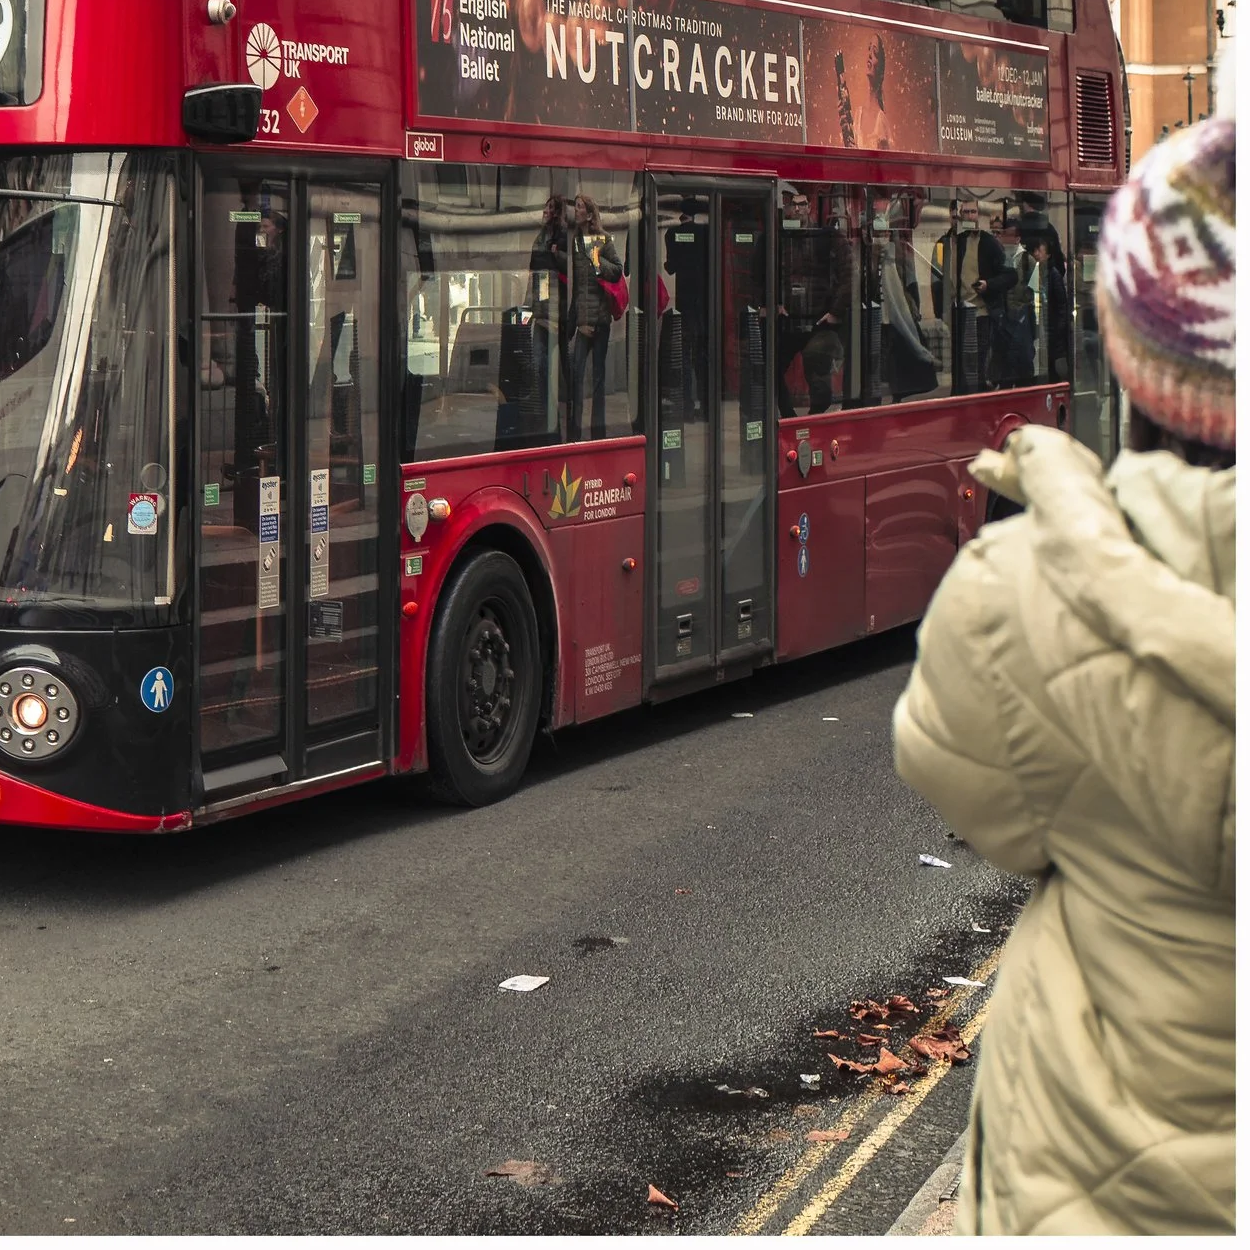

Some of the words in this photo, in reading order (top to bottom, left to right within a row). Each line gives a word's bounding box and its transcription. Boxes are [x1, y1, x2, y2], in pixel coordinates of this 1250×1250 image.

[568, 0, 614, 23] MAGICAL
[616, 8, 672, 31] CHRISTMAS
[674, 16, 723, 38] TRADITION
[460, 22, 515, 53] National
[281, 40, 350, 65] TRANSPORT
[283, 59, 301, 79] UK
[460, 53, 500, 82] Ballet
[545, 22, 801, 105] NUTCRACKER
[1005, 67, 1018, 84] DEC
[1031, 71, 1043, 86] JAN
[975, 86, 1044, 109] ballet.org.uk/nutcracker
[715, 105, 744, 122] BRAND
[746, 108, 765, 124] NEW
[766, 110, 783, 126] FOR
[784, 113, 802, 127] 2024
[946, 114, 967, 124] LONDON
[940, 126, 973, 142] COLISEUM
[413, 138, 437, 157] global
[584, 478, 603, 490] HYBRID
[129, 495, 157, 507] WARNING
[583, 510, 594, 521] FOR
[595, 507, 617, 519] LONDON
